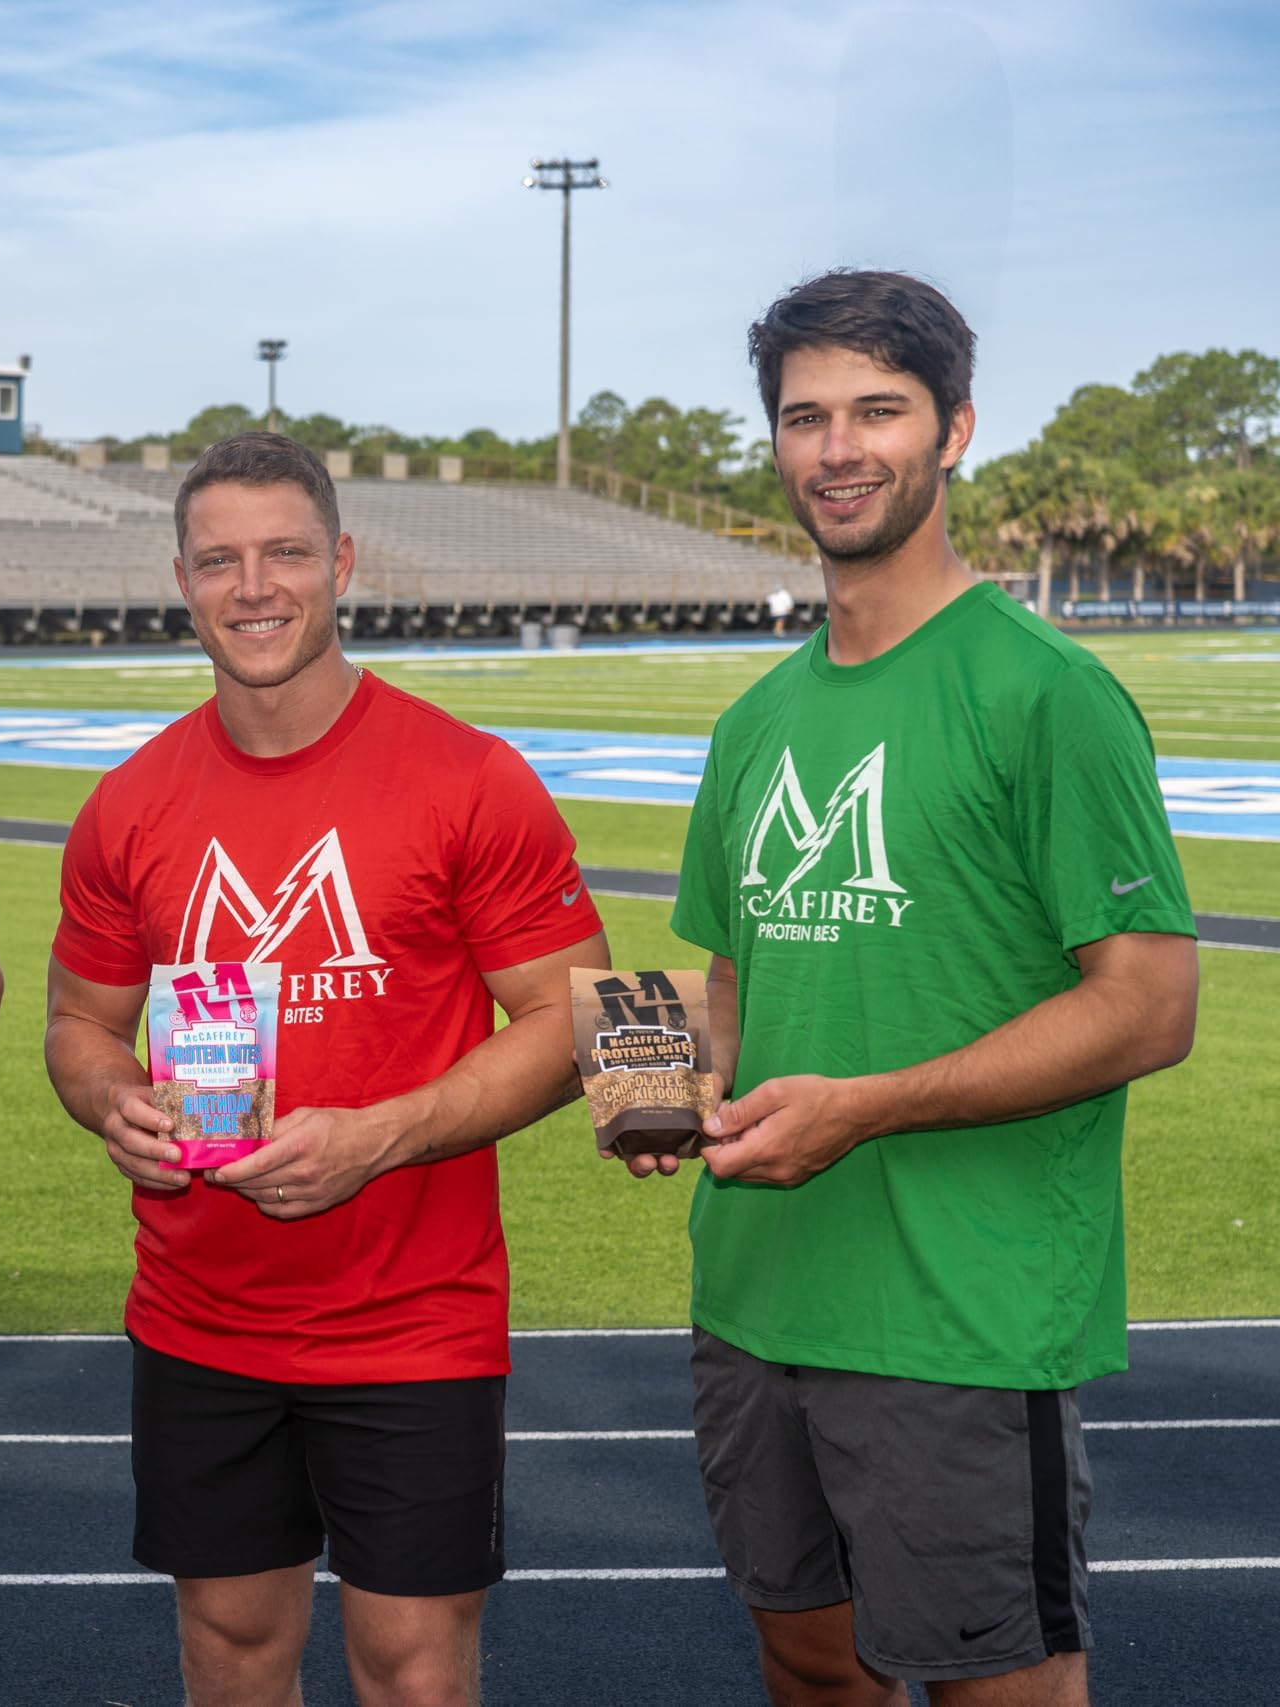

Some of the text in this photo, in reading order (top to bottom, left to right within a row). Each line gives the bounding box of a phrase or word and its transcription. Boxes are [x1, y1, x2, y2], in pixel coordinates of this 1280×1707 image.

[757, 922, 812, 941] PROTEIN
[283, 1005, 325, 1025] BITES
[183, 1031, 246, 1043] McCAFFREY
[608, 1035, 674, 1048] McCAFFREY
[165, 1044, 263, 1066] PROTEIN BITES
[591, 1041, 697, 1063] PROTEIN BITES
[603, 1074, 674, 1103] CHOCOLATE
[612, 1086, 655, 1111] COOKIE
[183, 1093, 253, 1115] BIRTHDAY
[201, 1113, 239, 1135] CAKE
